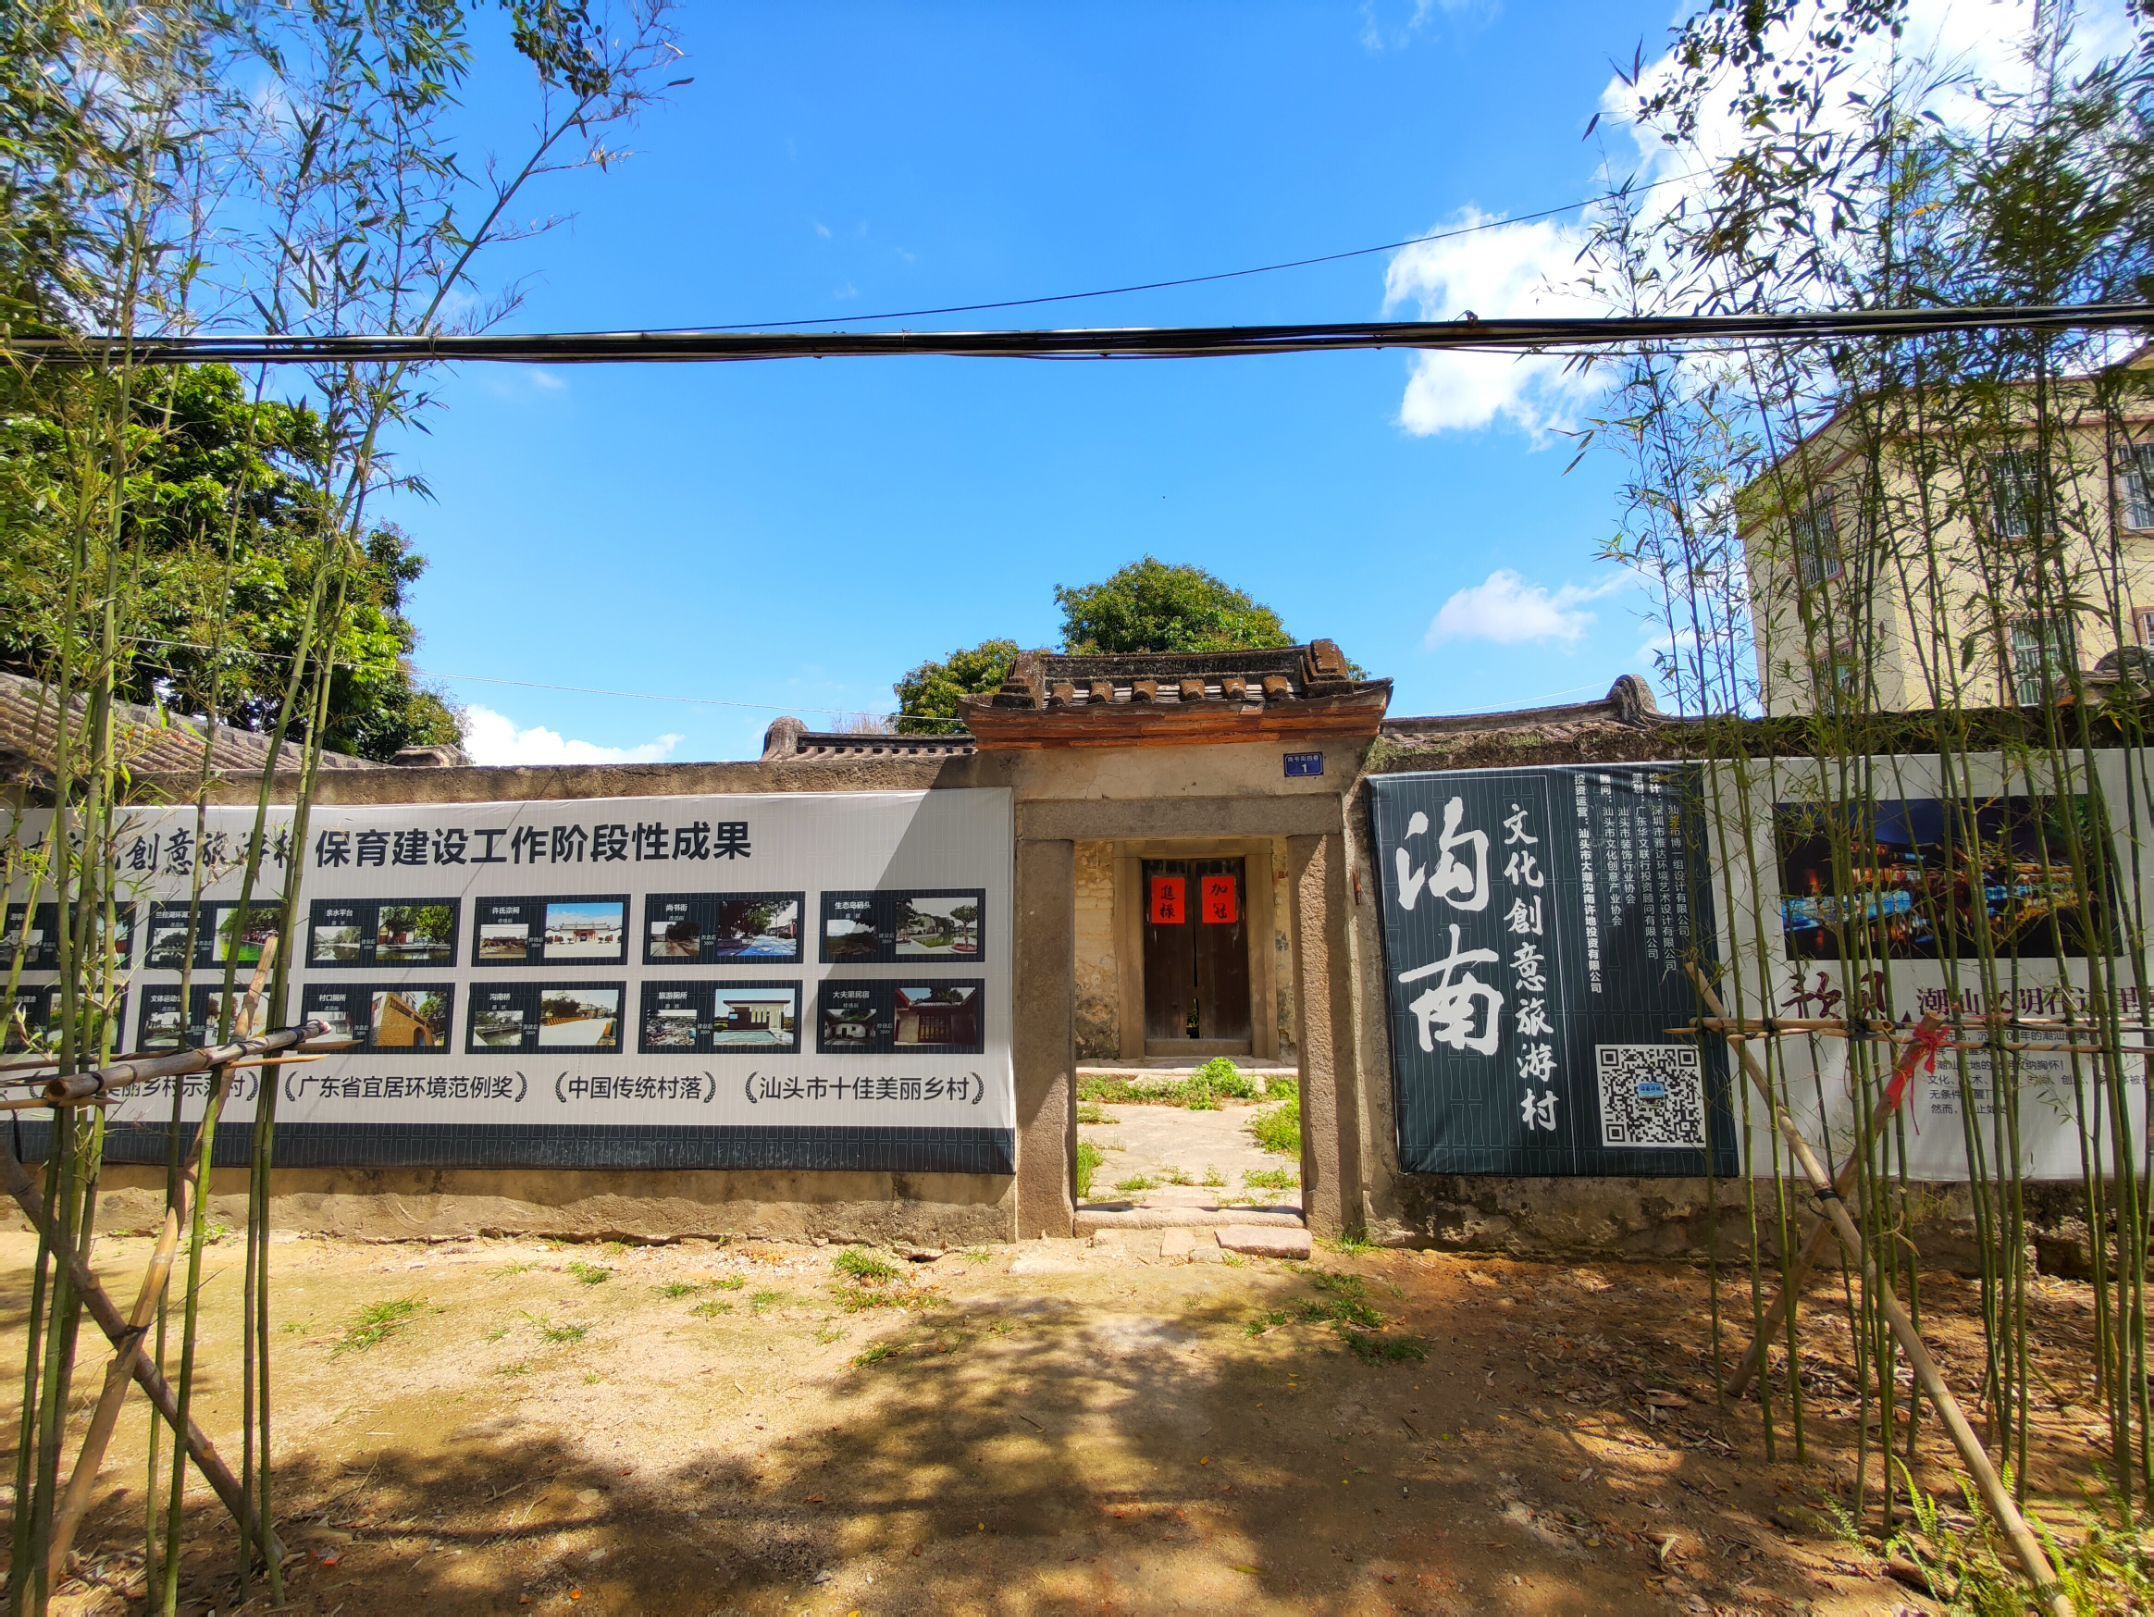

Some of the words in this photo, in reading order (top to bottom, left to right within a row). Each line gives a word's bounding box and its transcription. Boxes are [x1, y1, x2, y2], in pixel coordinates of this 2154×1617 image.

[1302, 764, 1307, 773] 1
[315, 820, 752, 868] 保育建设工作阶段性成果
[1618, 807, 1636, 905] 汕头市装饰行业协会
[666, 904, 688, 912] 尚书街
[1211, 882, 1228, 919] 加冠
[1396, 796, 1504, 1056] 沟南
[297, 1074, 514, 1100] 广东省宜居环境范例奖
[568, 1076, 704, 1100] 中国传统村落
[759, 1075, 970, 1101] 汕头市十佳美丽乡村
